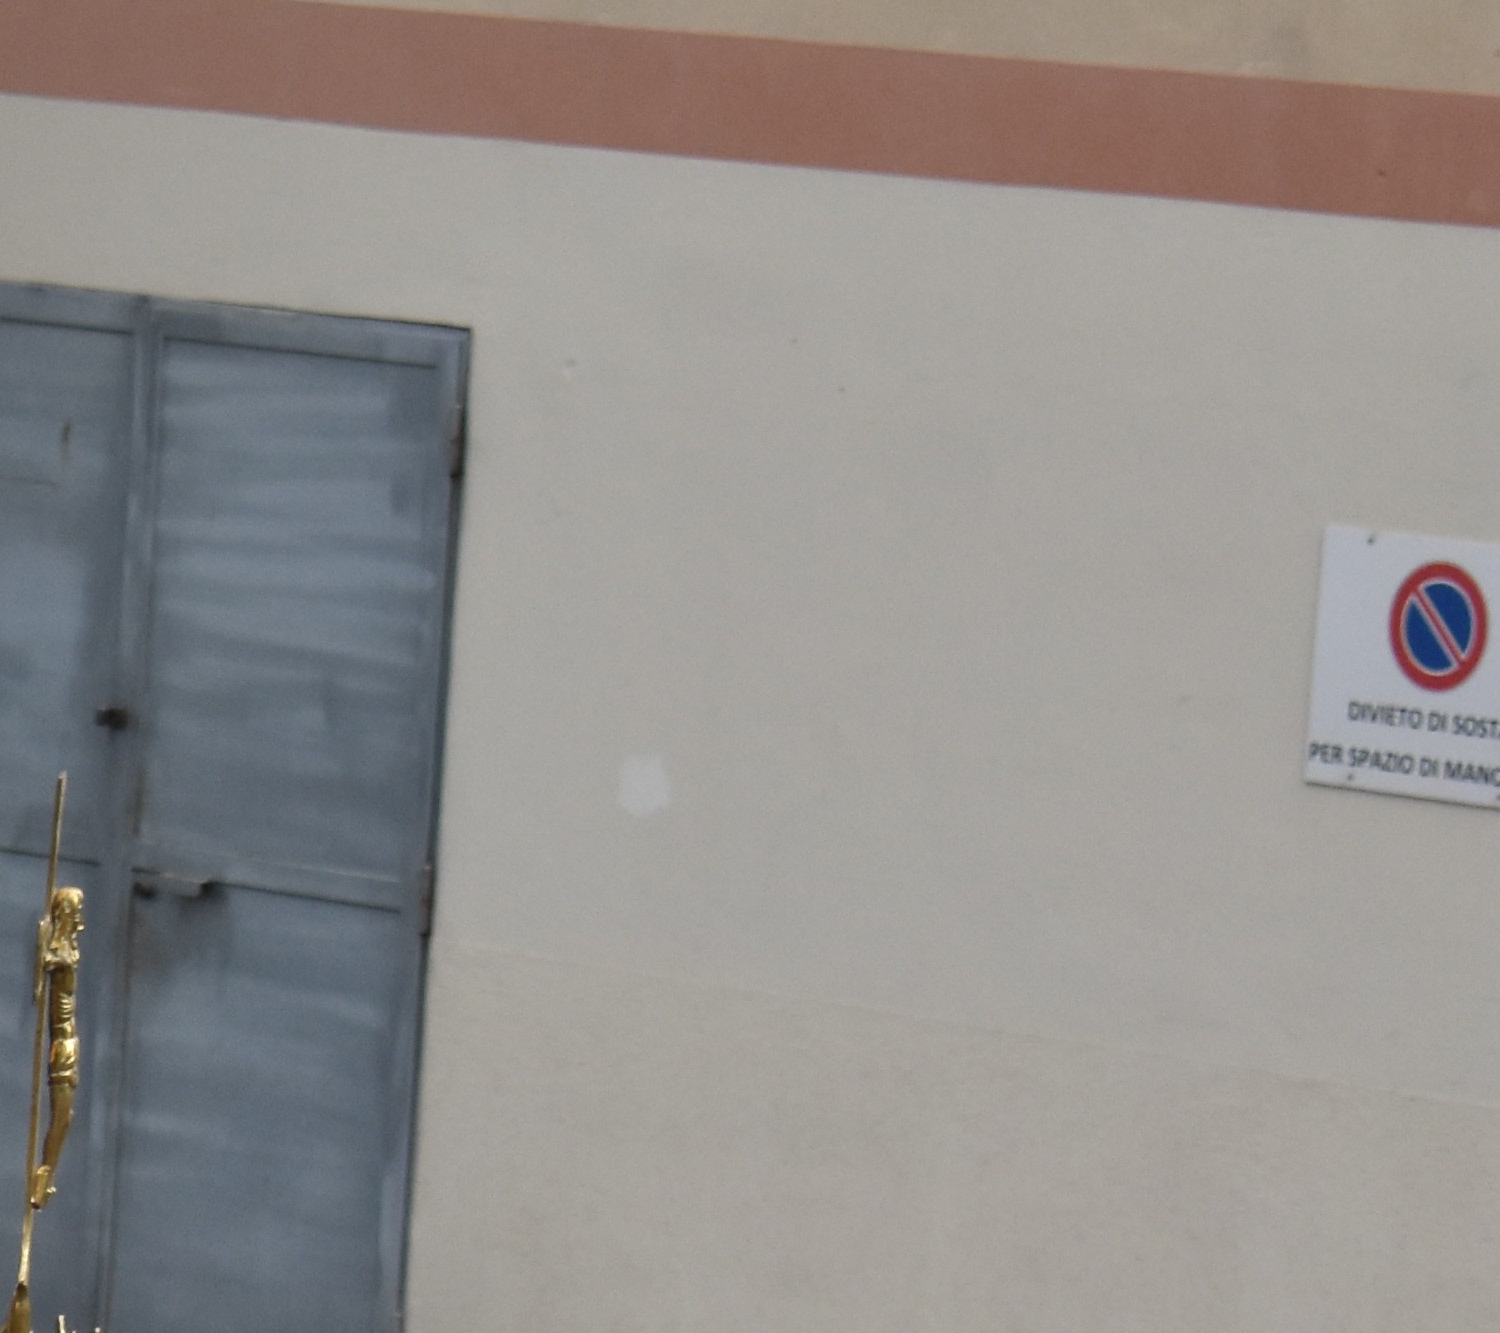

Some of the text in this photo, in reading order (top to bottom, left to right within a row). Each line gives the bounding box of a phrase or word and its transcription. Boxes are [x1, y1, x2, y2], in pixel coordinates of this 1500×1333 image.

[1348, 701, 1500, 740] DIVIETO DI SOST
[1308, 742, 1343, 764] PER
[1348, 746, 1414, 774] SPAZIO
[1419, 756, 1439, 777] DI
